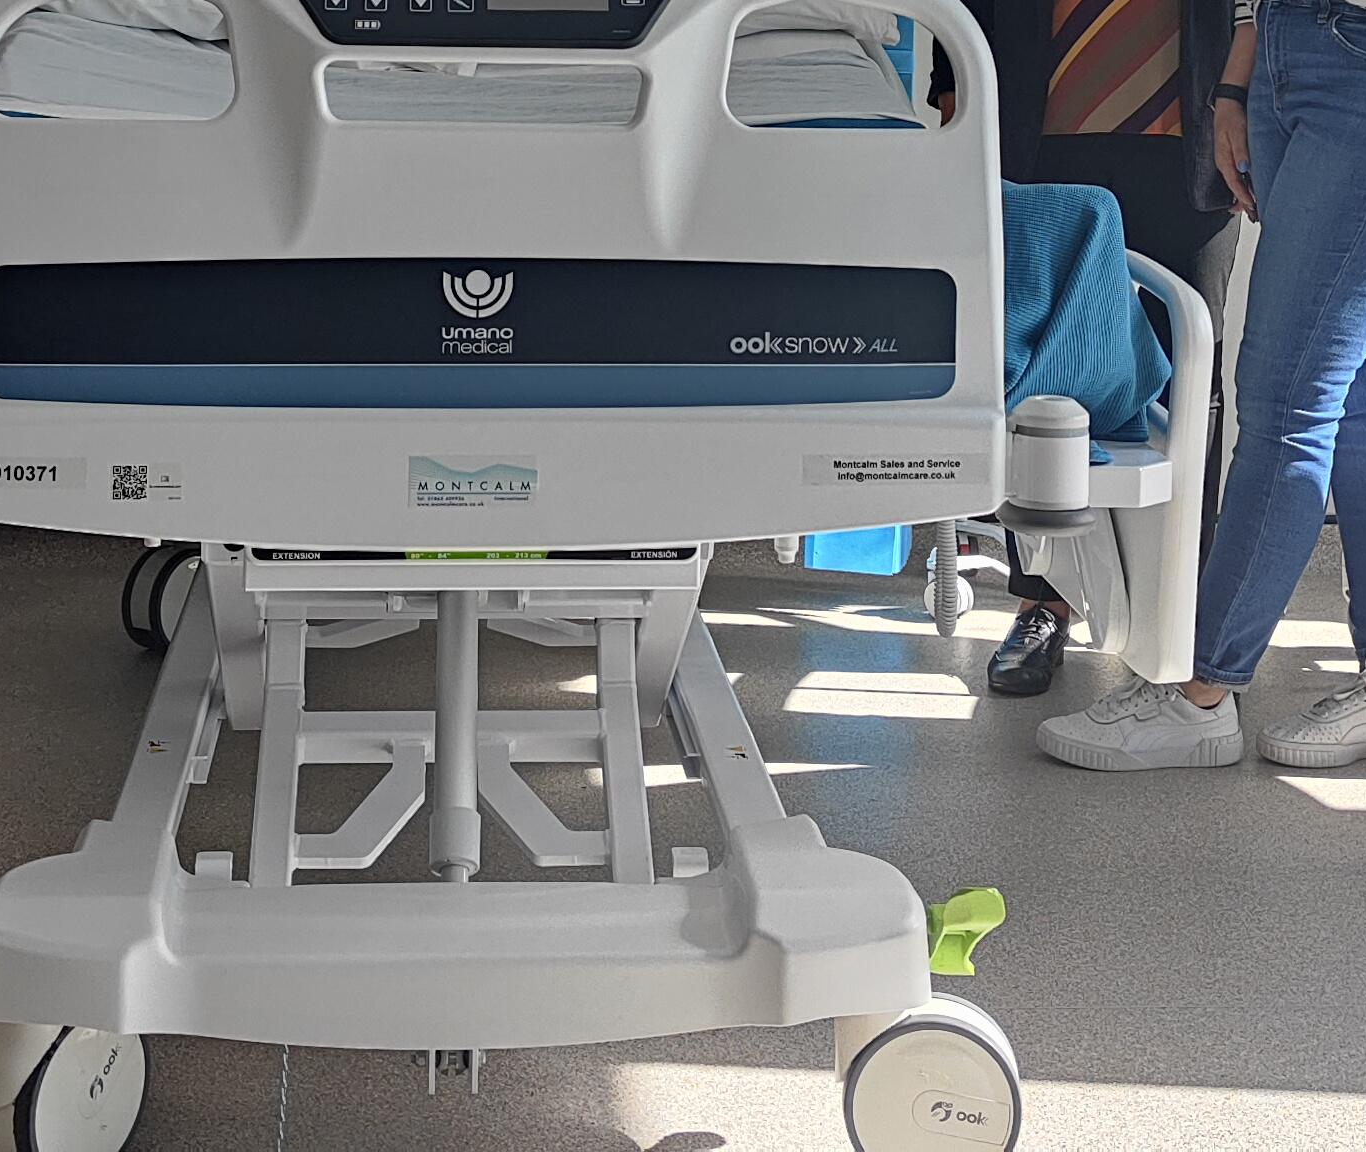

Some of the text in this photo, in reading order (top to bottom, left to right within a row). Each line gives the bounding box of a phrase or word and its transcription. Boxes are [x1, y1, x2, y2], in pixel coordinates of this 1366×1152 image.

[441, 326, 514, 339] umano
[441, 339, 513, 354] medical
[784, 336, 850, 354] snow
[869, 338, 898, 353] ALL
[834, 459, 961, 469] Montcalm Sales and Service
[417, 481, 532, 491] MONTCALM
[272, 552, 321, 560] EXTENSION
[630, 549, 678, 559] EXTENSIÓN
